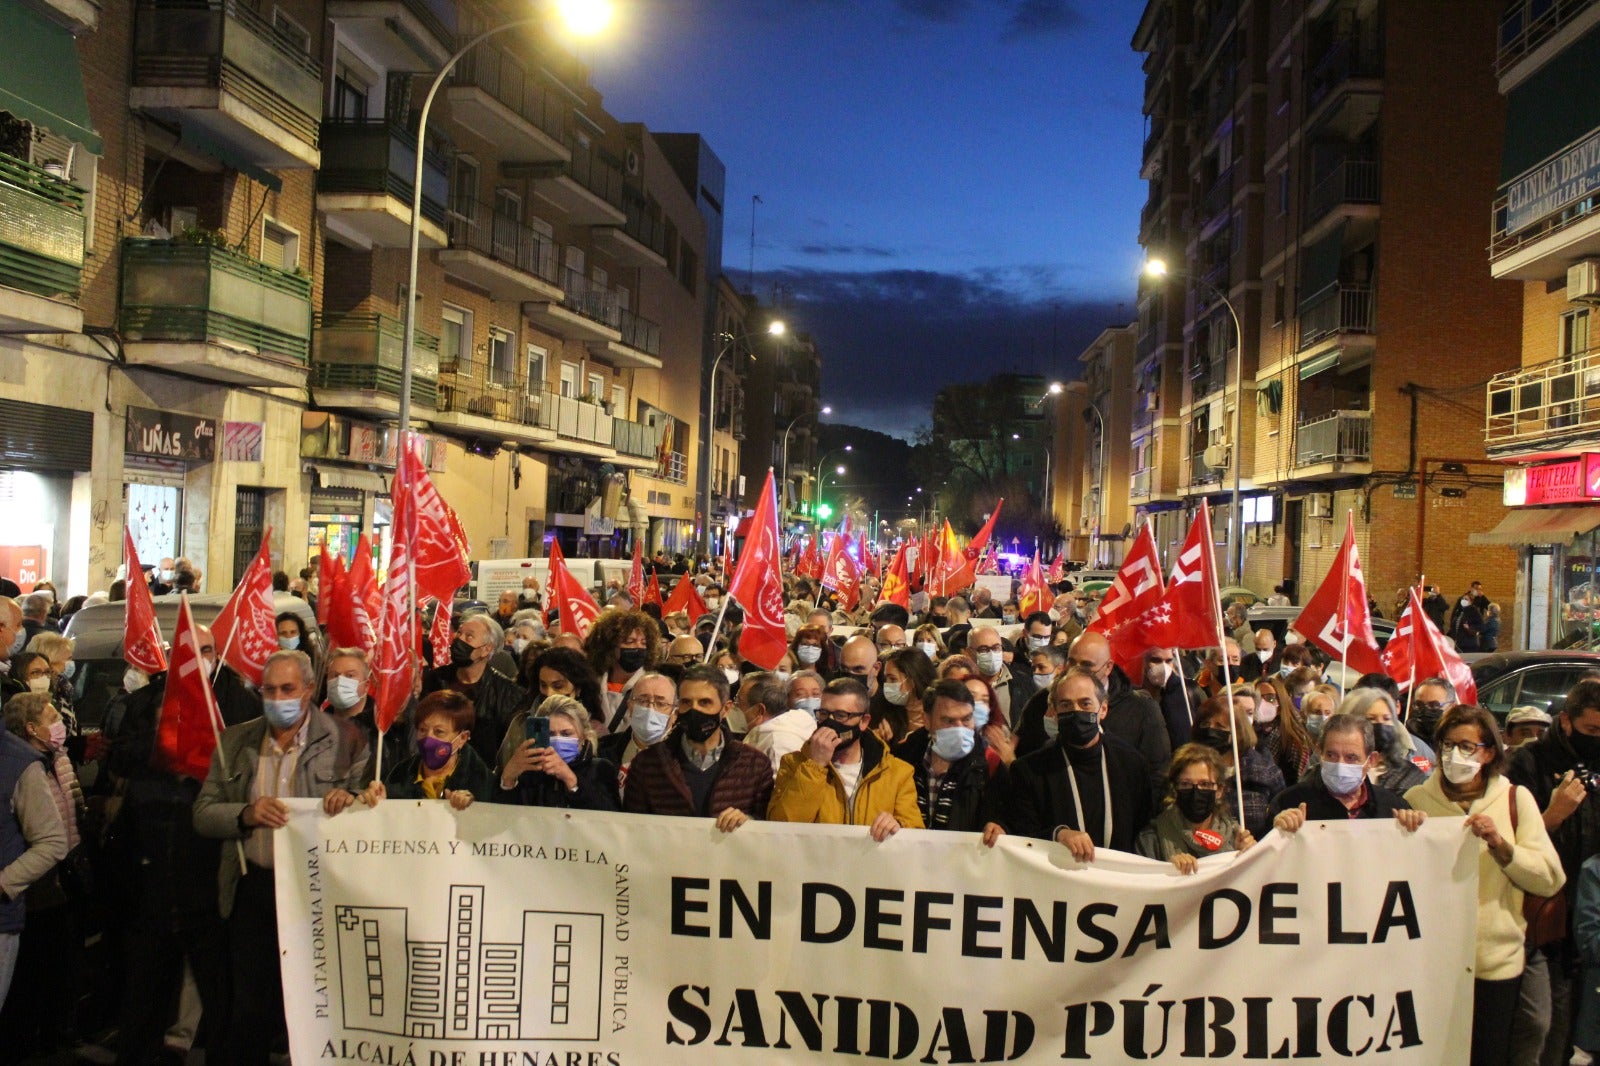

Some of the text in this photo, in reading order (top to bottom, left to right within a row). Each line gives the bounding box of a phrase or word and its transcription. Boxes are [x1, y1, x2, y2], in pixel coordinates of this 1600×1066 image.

[143, 424, 181, 456] UÑAS
[1530, 465, 1577, 489] FRUTERIA
[1542, 487, 1580, 499] AUTOSERVIC
[325, 839, 608, 865] LA DEFENSA Y MEJORA DE LA
[307, 845, 329, 1019] PLATAFORMA PARA
[671, 876, 1421, 964] EN DEFENSA DE LA
[612, 863, 632, 1033] SANIDAD PÚBLICA
[666, 983, 1424, 1065] SANIDAD PÚBLICA
[320, 1039, 621, 1066] ALCALÁ DE HENARES
